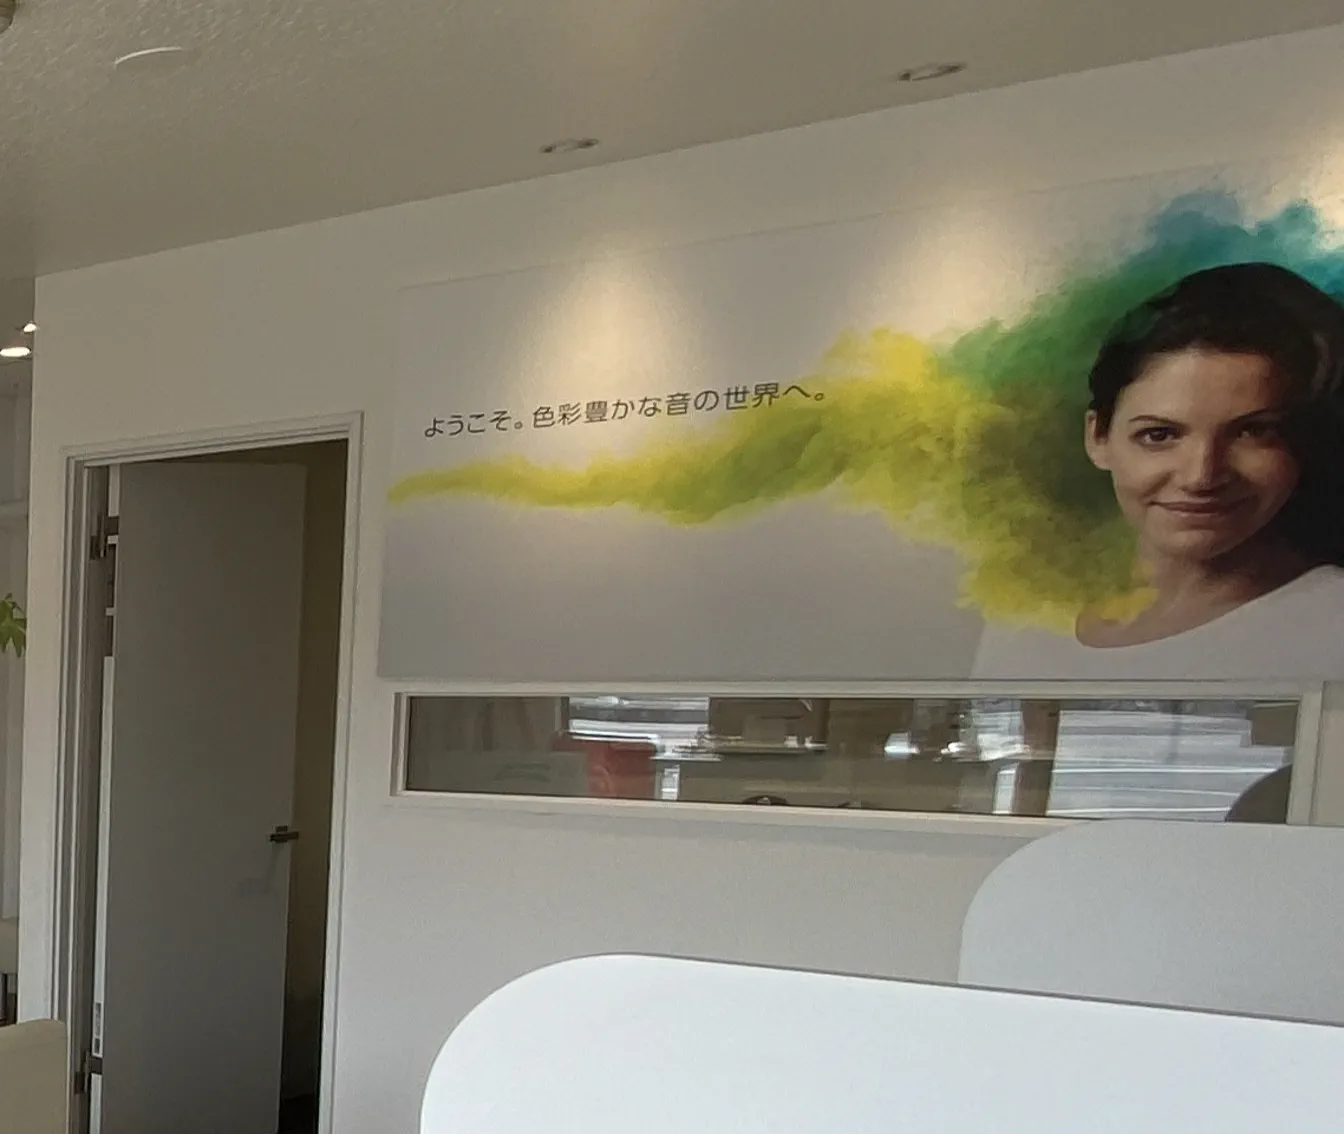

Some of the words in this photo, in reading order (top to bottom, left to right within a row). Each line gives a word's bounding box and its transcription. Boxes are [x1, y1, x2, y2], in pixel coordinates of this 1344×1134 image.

[424, 382, 825, 438] ようこそ。色彩豊かな音の世界へ。
